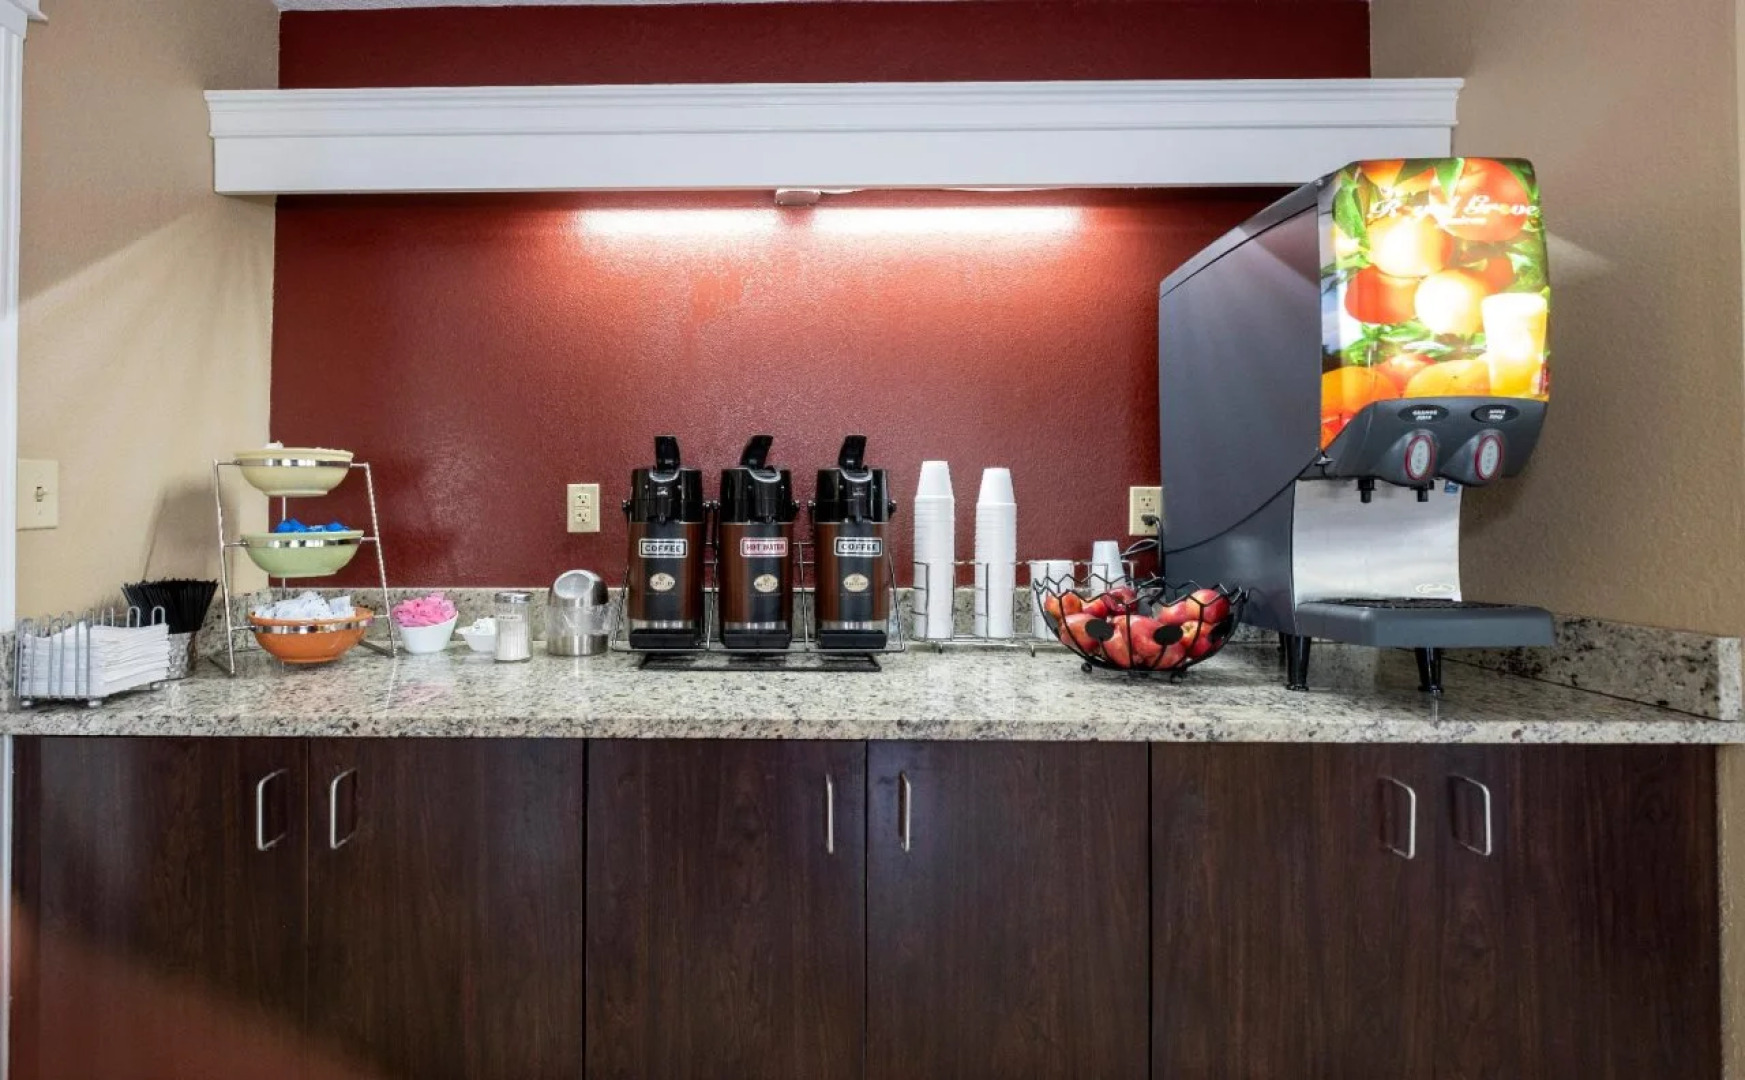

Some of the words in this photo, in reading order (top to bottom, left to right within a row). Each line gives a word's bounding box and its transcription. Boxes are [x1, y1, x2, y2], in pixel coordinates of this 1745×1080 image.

[644, 545, 681, 553] COFFEE
[746, 543, 760, 551] HOT
[761, 542, 785, 551] WATER
[841, 543, 877, 552] COFFEE
